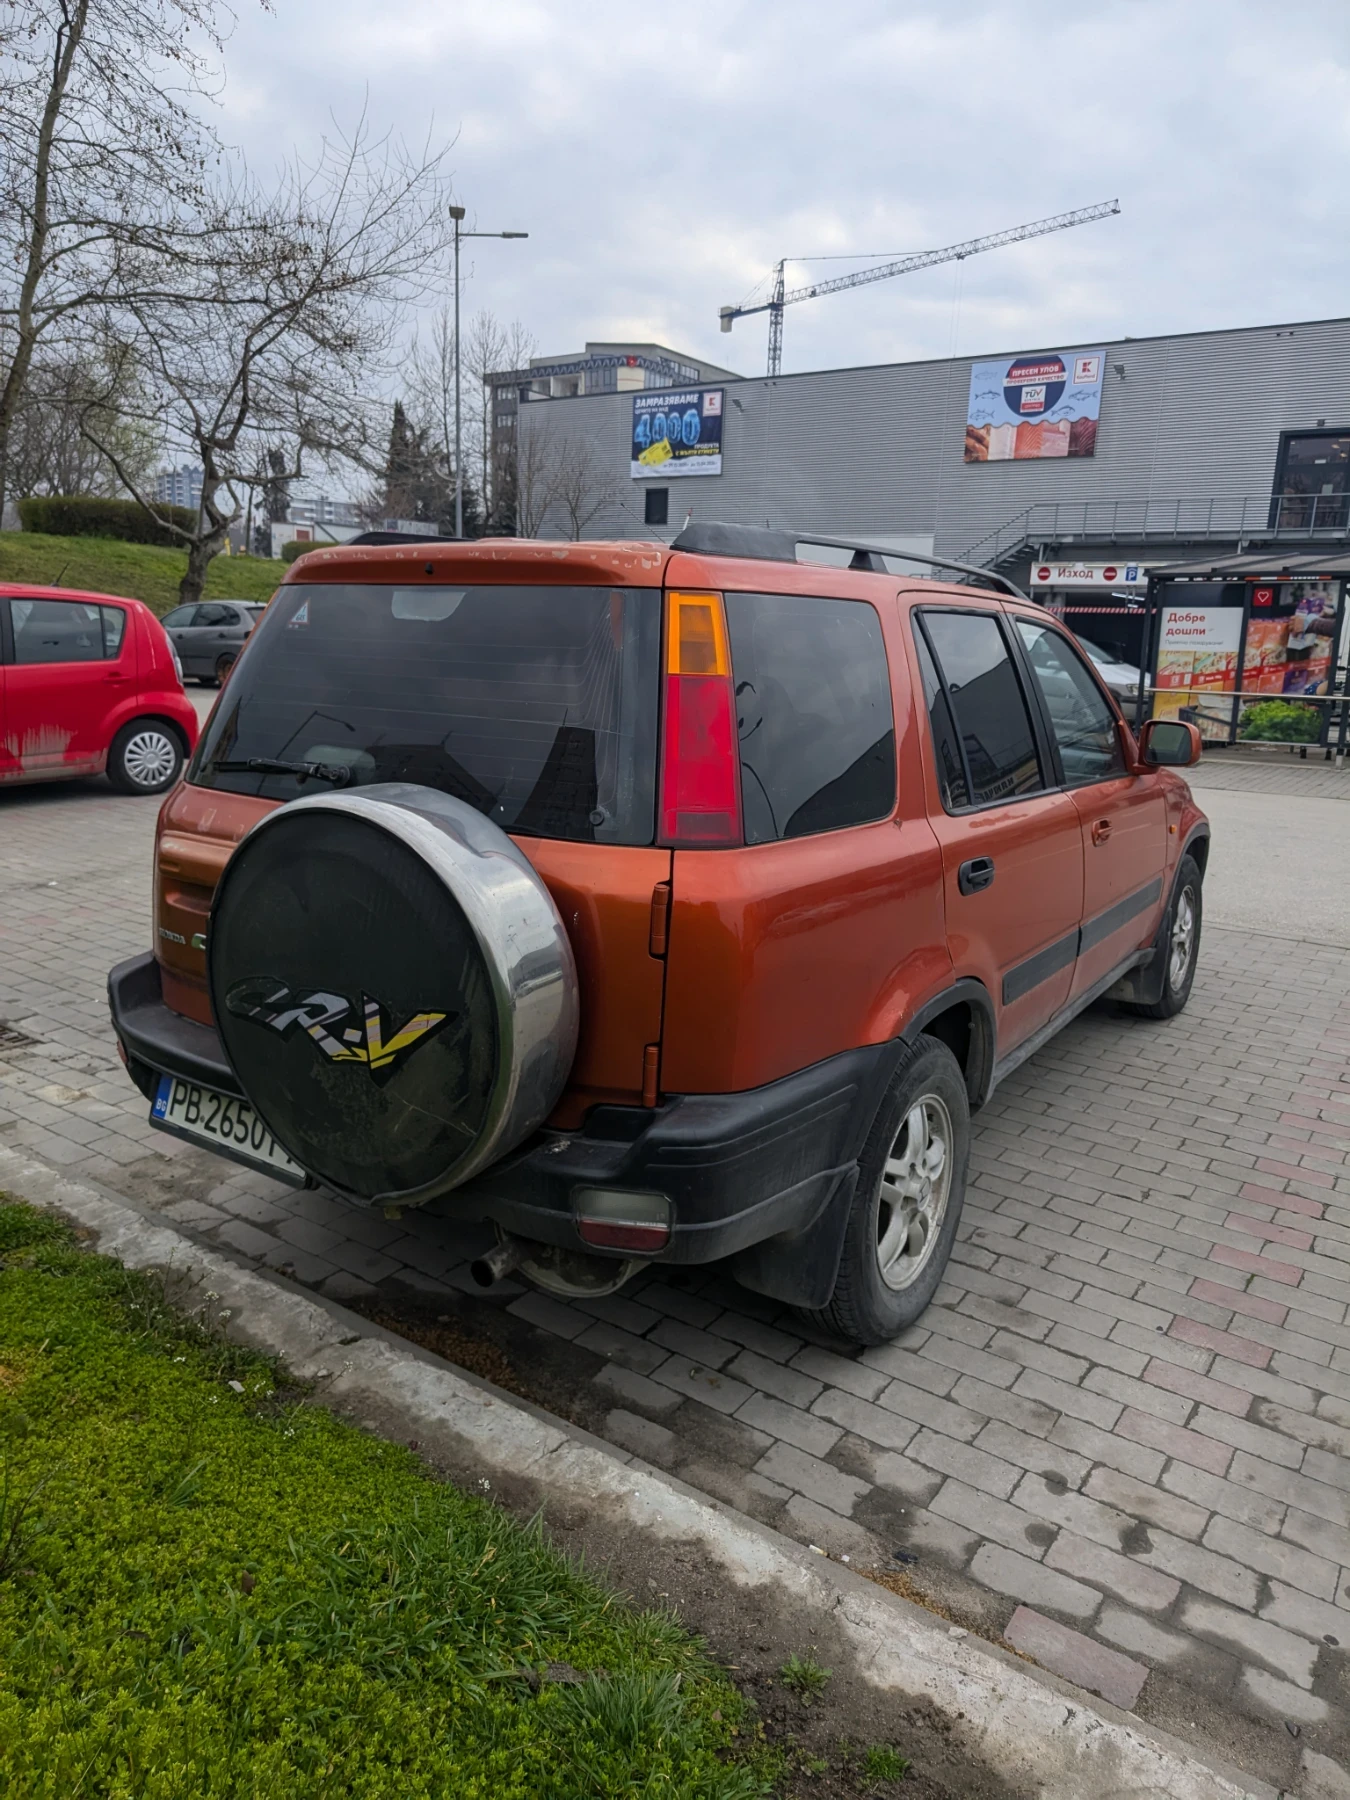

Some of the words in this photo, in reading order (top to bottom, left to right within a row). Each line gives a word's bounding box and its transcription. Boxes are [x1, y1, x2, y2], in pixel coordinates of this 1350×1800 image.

[1012, 368, 1039, 377] ПРЕСЕН
[1040, 365, 1059, 374] УЛОВ
[1006, 377, 1037, 385] ПРОВЕРЕНО
[1037, 374, 1065, 382] КАЧЕСТВО
[1025, 389, 1043, 398] TÜV
[635, 394, 699, 408] ЗАМРАЗЯВАМЕ
[634, 408, 700, 449] 4000
[1057, 567, 1093, 579] Изход
[1167, 612, 1206, 625] Добре
[1166, 627, 1206, 637] дошли
[155, 1098, 168, 1112] BG
